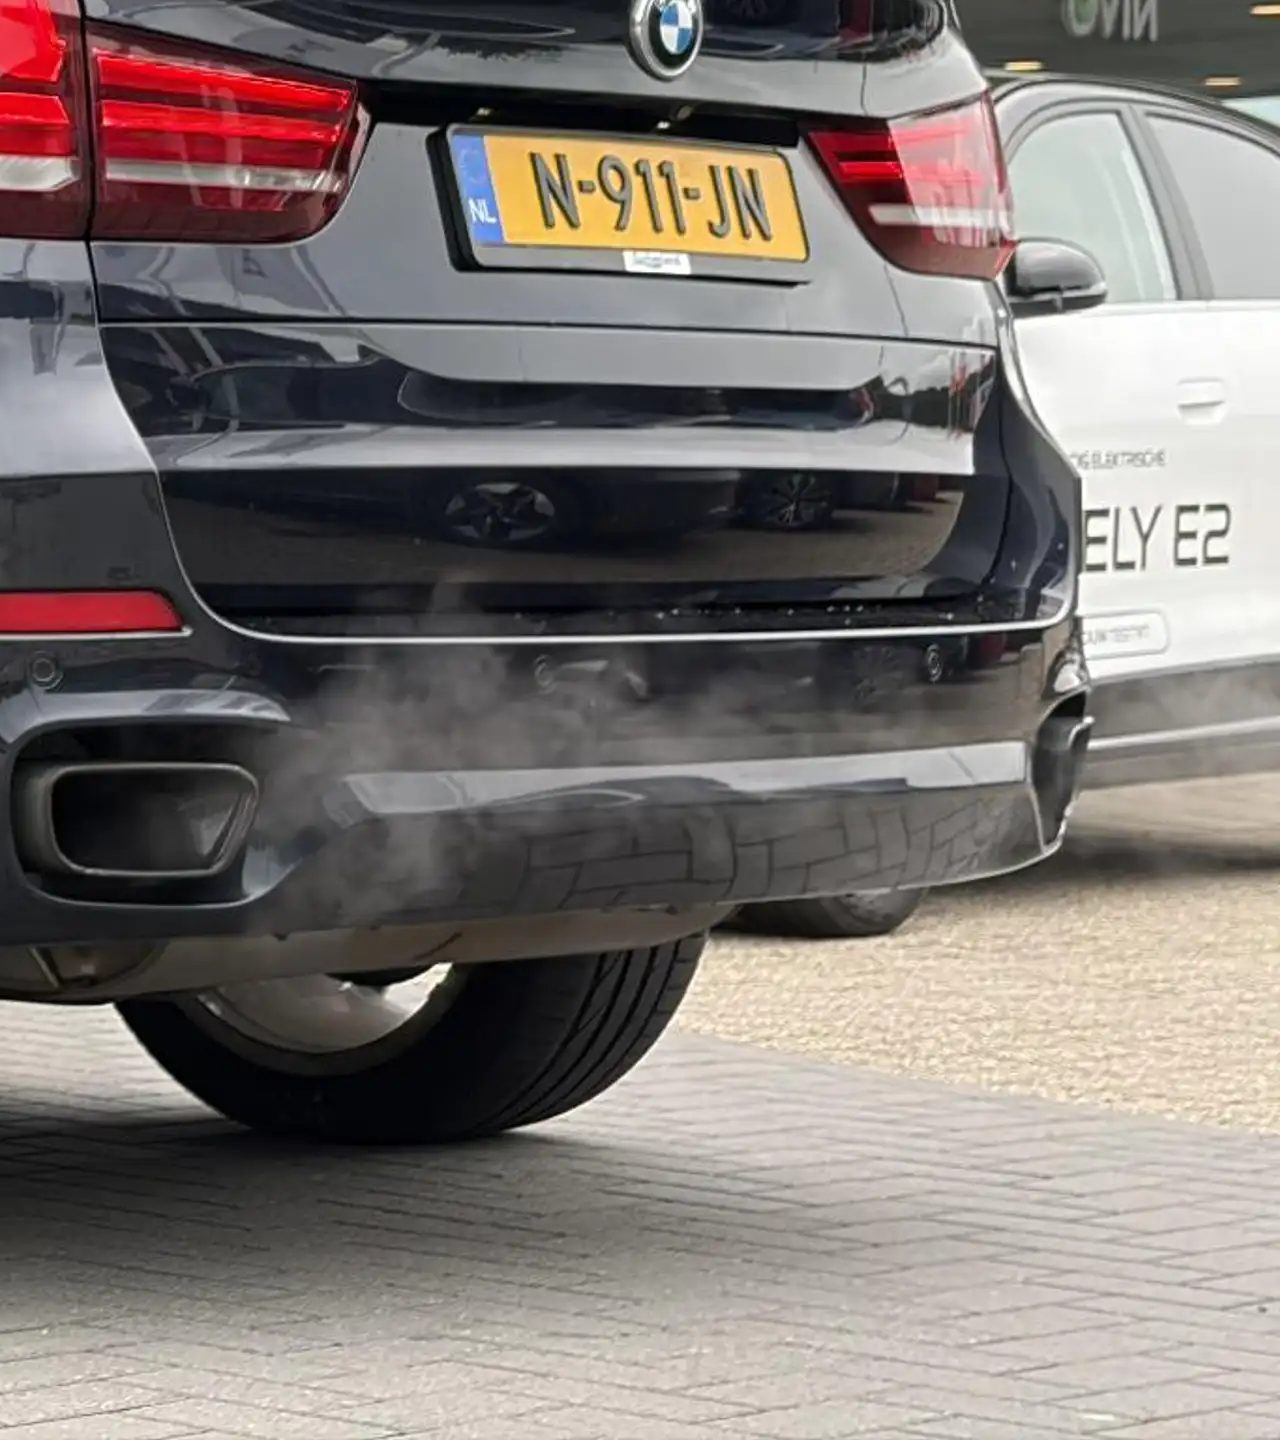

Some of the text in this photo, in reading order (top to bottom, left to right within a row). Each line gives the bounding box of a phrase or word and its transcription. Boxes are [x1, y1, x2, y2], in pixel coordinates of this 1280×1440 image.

[468, 199, 497, 225] NL
[529, 152, 773, 241] N-911-JN
[1174, 503, 1231, 566] E2
